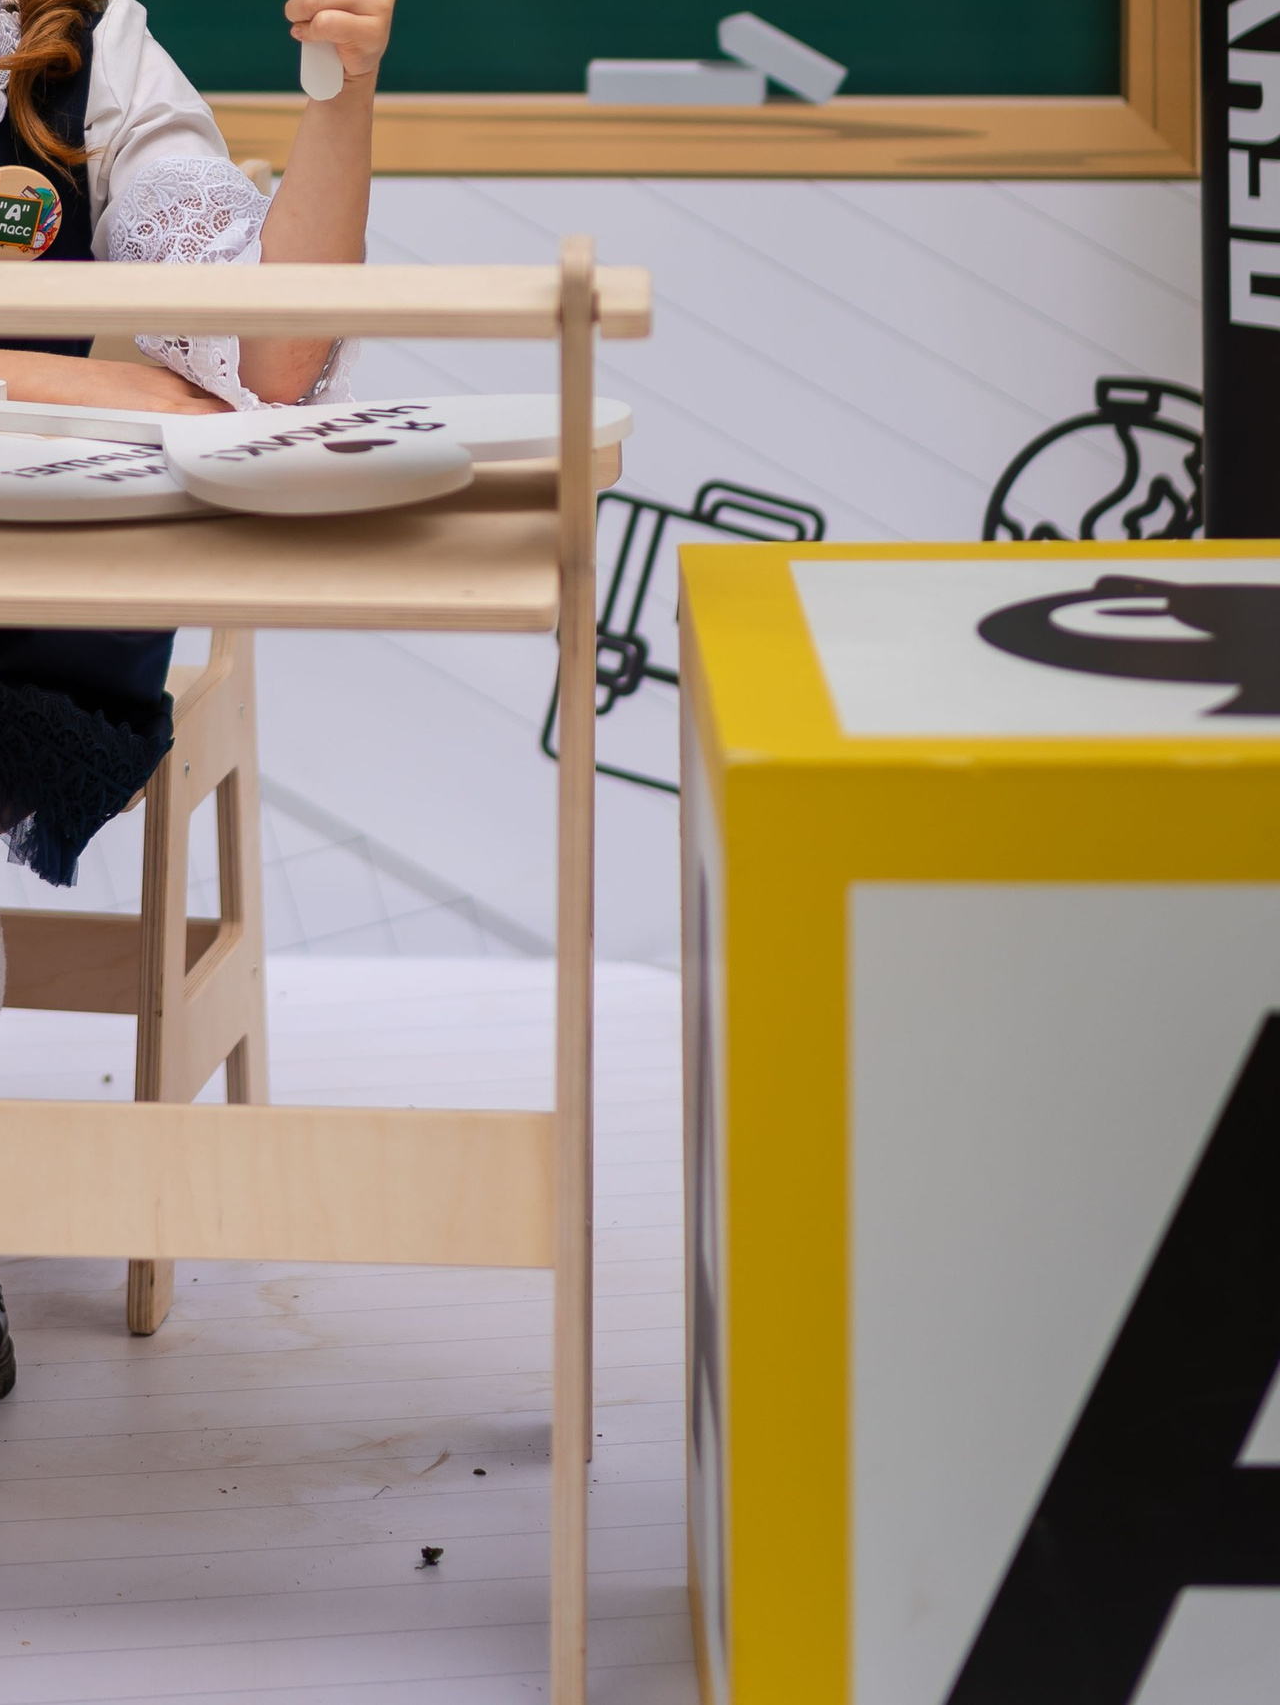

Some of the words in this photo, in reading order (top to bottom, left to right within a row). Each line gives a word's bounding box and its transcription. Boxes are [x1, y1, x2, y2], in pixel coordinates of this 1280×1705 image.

[199, 404, 432, 462] ЧИЖИК!
[390, 421, 446, 432] Я
[0, 446, 164, 479] ЛЬШЕ!
